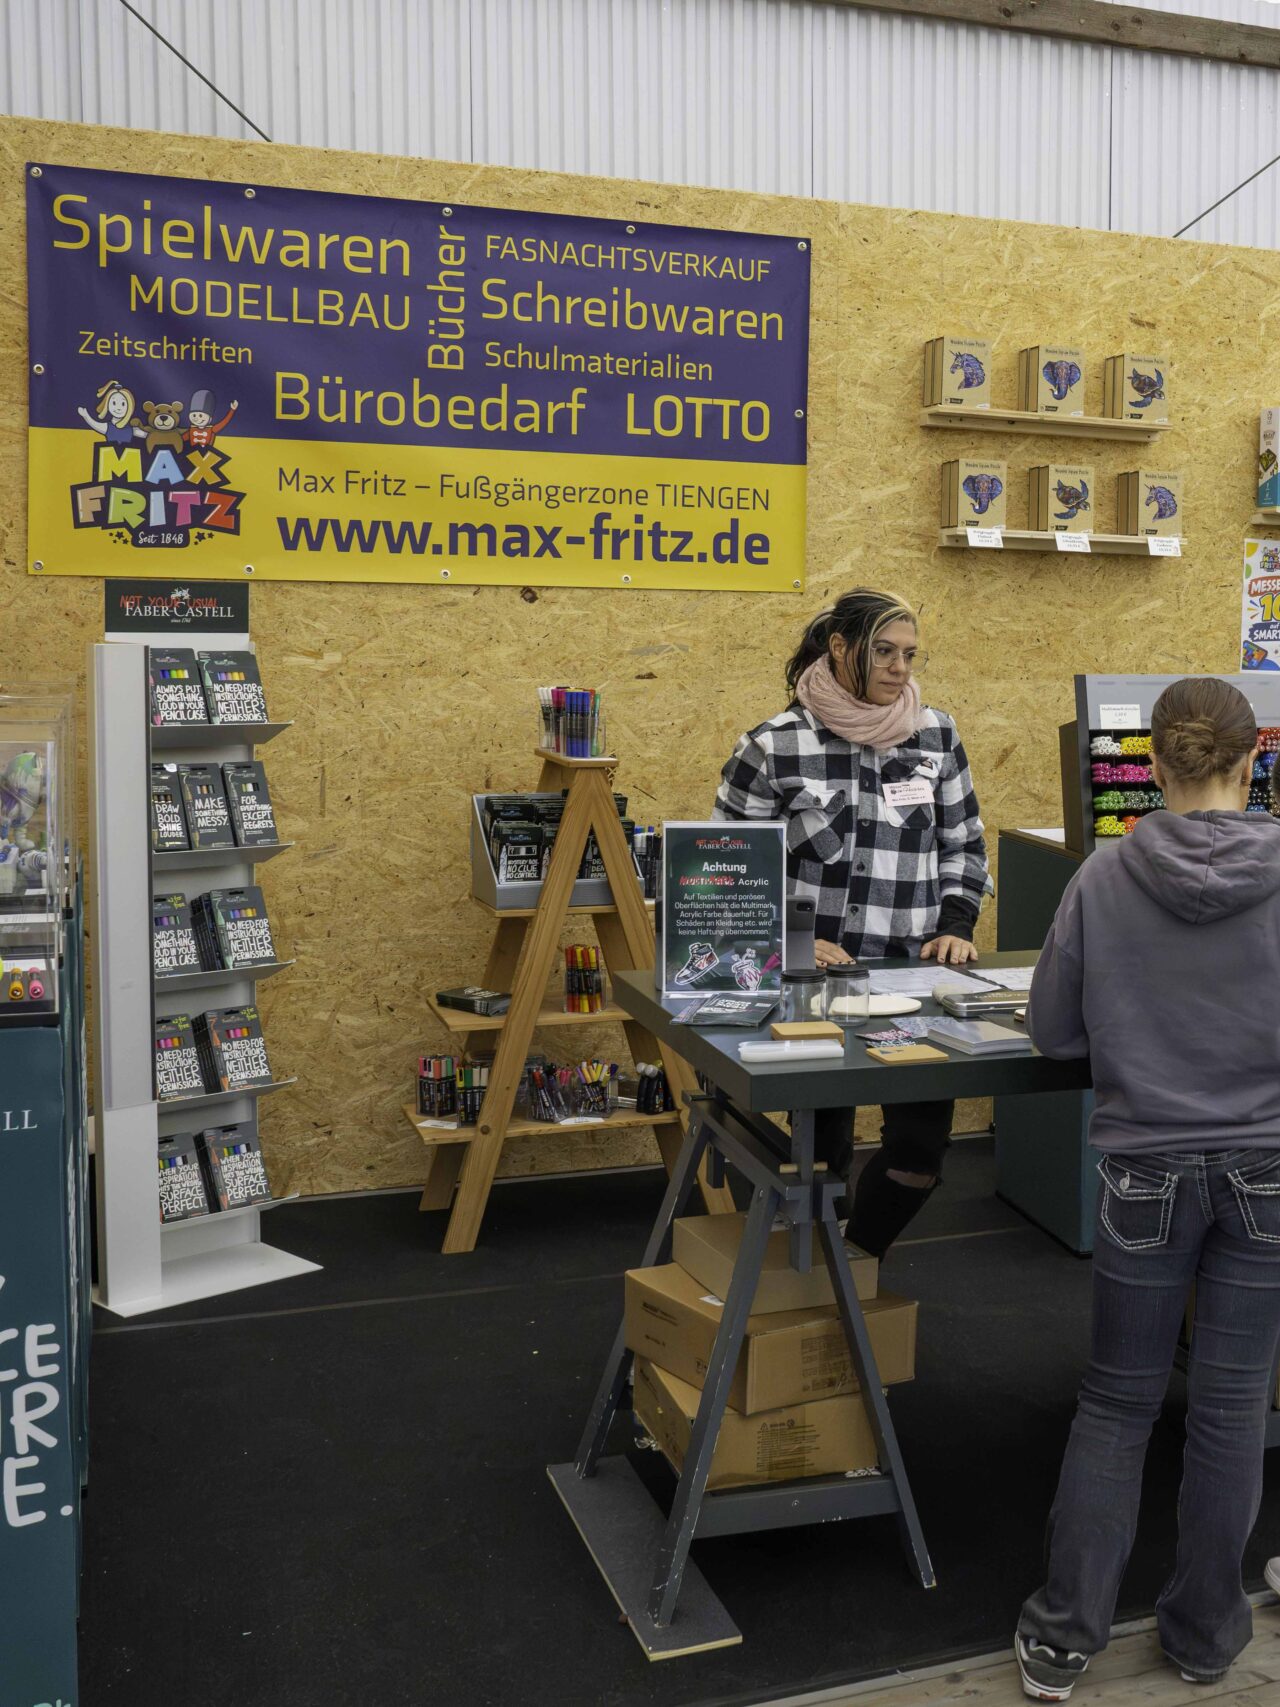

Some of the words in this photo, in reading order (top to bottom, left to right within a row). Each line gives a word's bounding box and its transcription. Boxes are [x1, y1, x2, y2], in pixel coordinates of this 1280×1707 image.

[53, 194, 411, 276] Spielwaren
[486, 235, 770, 281] FASNACHTSVERKAUF
[131, 274, 410, 330] MODELLBAU
[428, 226, 466, 370] Bücher
[482, 278, 783, 340] Schreibwaren
[78, 330, 252, 364] Zeitschriften
[485, 342, 713, 381] Schulmaterialien
[275, 372, 586, 435] Bürobedarf
[626, 393, 770, 442] LOTTO
[98, 446, 222, 485] MAX
[278, 466, 335, 495] Max
[344, 469, 406, 497] Fritz
[440, 473, 649, 511] Fußgängerzone
[658, 484, 770, 510] TIENGEN
[77, 485, 237, 529] FRITZ
[139, 532, 158, 544] Seit
[161, 533, 183, 544] 1848
[279, 512, 770, 565] www.max-fritz.de
[120, 595, 143, 608] NOT
[148, 597, 180, 608] YOUR
[187, 598, 218, 608] USUAL
[125, 601, 234, 617] FABER-CASTELL
[156, 685, 183, 693] ALWAYS
[186, 685, 200, 693] PUT
[214, 684, 224, 692] NO
[225, 684, 242, 692] NEED
[243, 683, 257, 692] FOR
[159, 702, 177, 710] LOUD
[185, 701, 204, 710] YOUR
[218, 700, 260, 713] NEITHER
[160, 710, 187, 720] PENCIL
[195, 797, 224, 809] MAKE
[241, 796, 256, 804] FOR
[156, 804, 179, 813] DRAW
[242, 811, 271, 820] EXCEPT
[159, 822, 182, 831] SHINE
[508, 865, 518, 873] NO
[702, 862, 747, 873] Achtung
[738, 878, 769, 887] Acrylic
[738, 893, 765, 901] porösen
[680, 911, 702, 919] Acrylic
[226, 922, 237, 931] NO
[238, 920, 255, 929] NEED
[255, 919, 269, 928] FOR
[177, 929, 192, 937] PUT
[177, 945, 196, 954] YOUR
[231, 936, 272, 952] NEITHER
[222, 1042, 232, 1051] NO
[233, 1040, 250, 1049] NEED
[251, 1037, 264, 1047] FOR
[163, 1049, 181, 1059] NEED
[182, 1047, 197, 1057] FOR
[226, 1055, 267, 1072] NEITHER
[220, 1154, 240, 1165] WHEN
[241, 1151, 261, 1159] YOUR
[177, 1163, 199, 1171] YOUR
[221, 1158, 260, 1173] INSPIRATION
[225, 1173, 267, 1189] SURFACE
[160, 1186, 204, 1202] SURFACE
[227, 1183, 270, 1200] PERFECT.
[162, 1196, 207, 1214] PERFECT.
